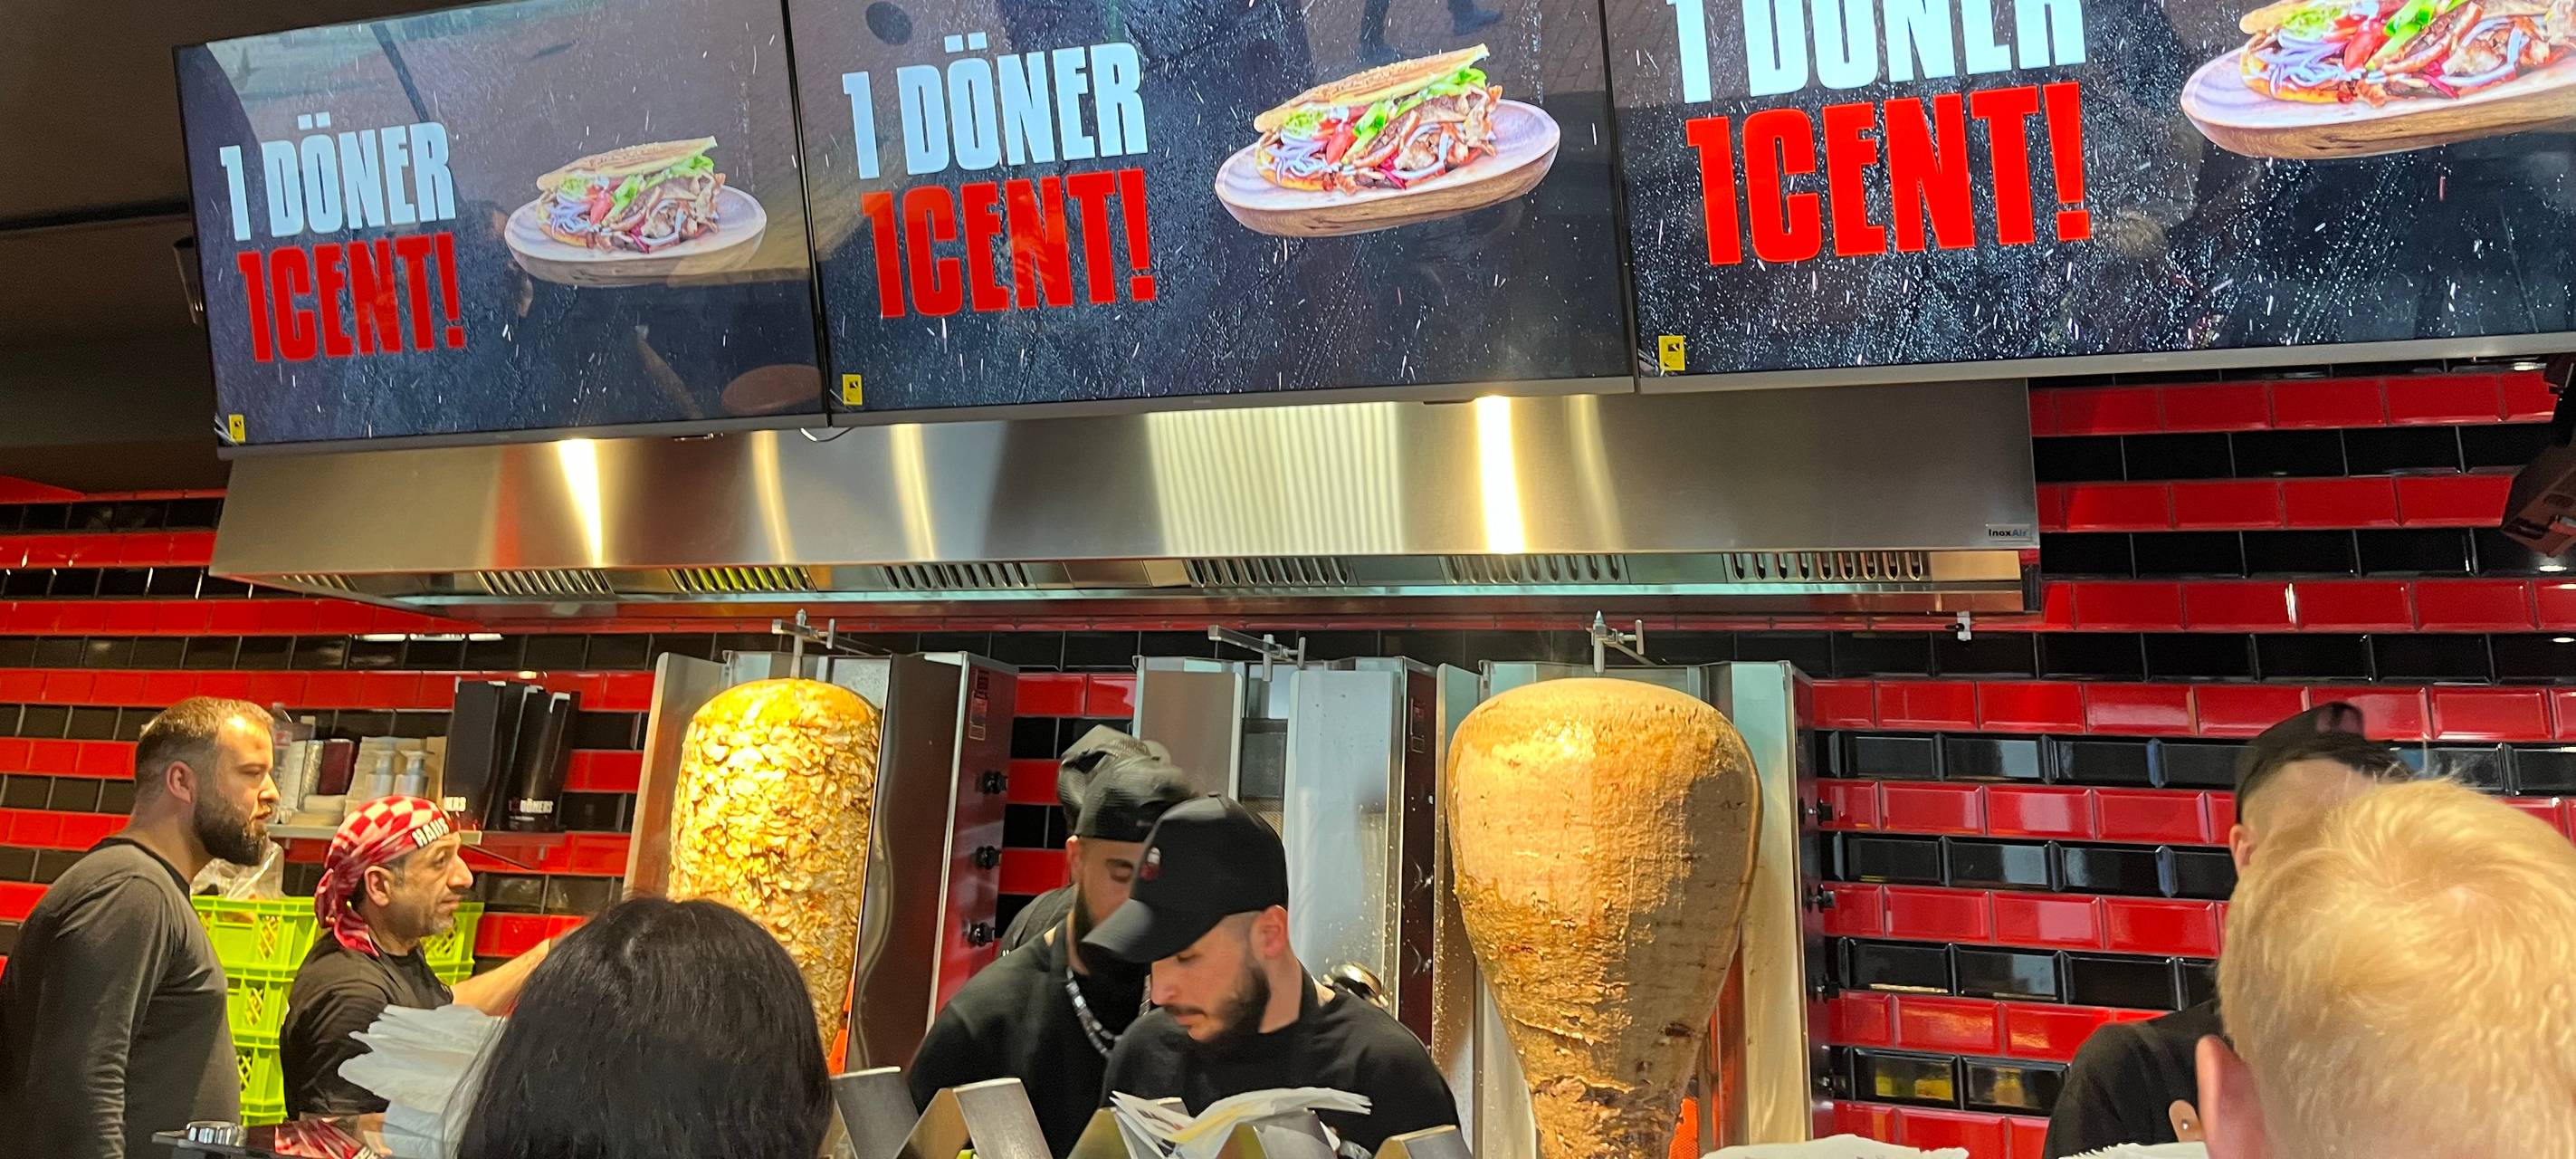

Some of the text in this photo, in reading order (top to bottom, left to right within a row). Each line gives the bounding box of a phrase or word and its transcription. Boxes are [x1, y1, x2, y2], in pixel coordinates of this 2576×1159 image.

[842, 32, 1148, 179] 1 DÖNER
[1666, 0, 1712, 103] 1
[219, 111, 456, 242] 1 DÖNER
[1685, 81, 2091, 265] 1CENT!
[236, 231, 465, 363] 1CENT!
[862, 168, 1156, 318] 1CENT!
